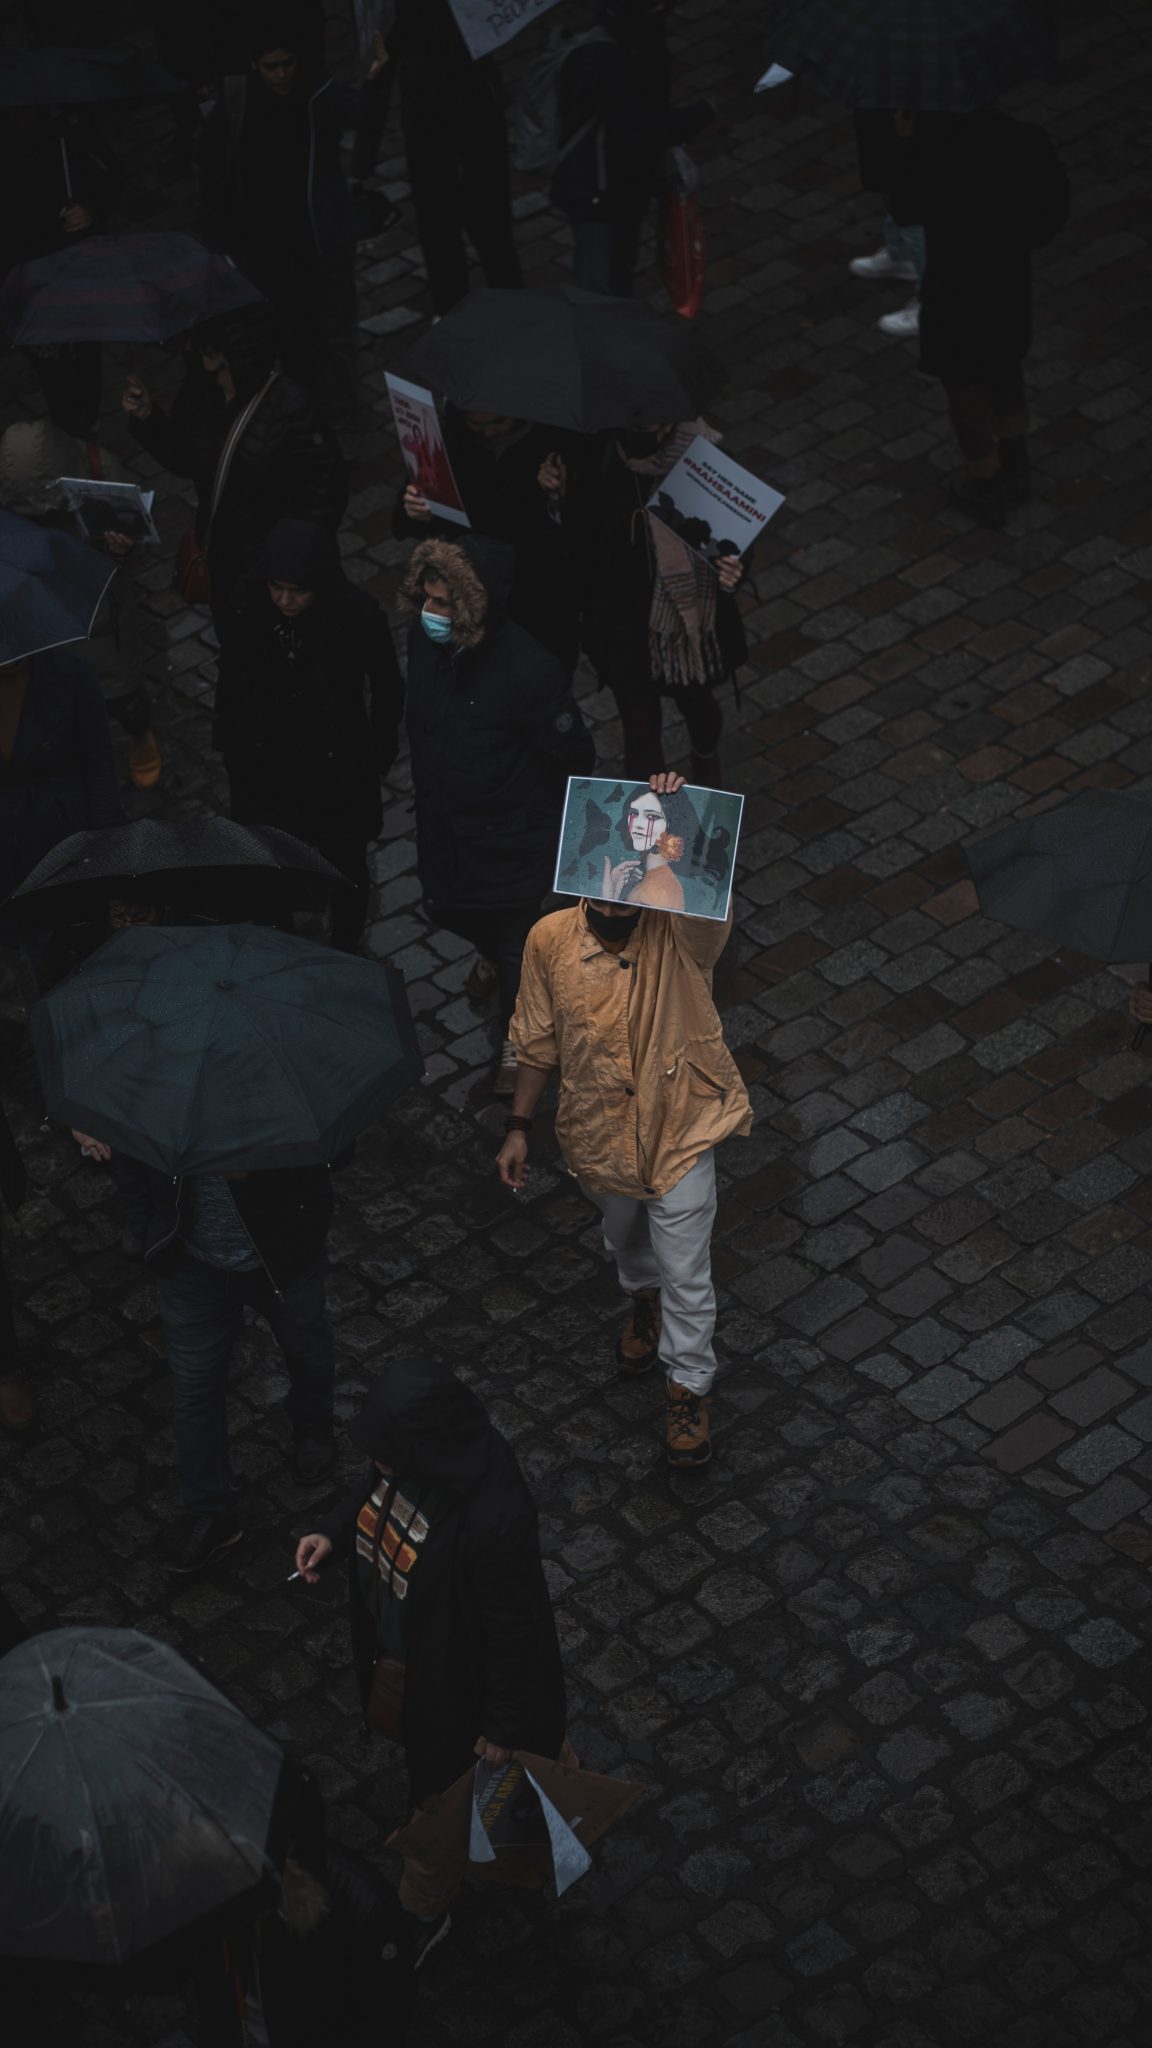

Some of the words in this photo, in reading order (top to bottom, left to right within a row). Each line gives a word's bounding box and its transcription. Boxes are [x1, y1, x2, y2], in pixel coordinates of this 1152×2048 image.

[683, 457, 766, 522] #MAHSAAMINI
[702, 462, 717, 474] SAY
[717, 473, 733, 488] HER
[733, 486, 757, 504] NAME
